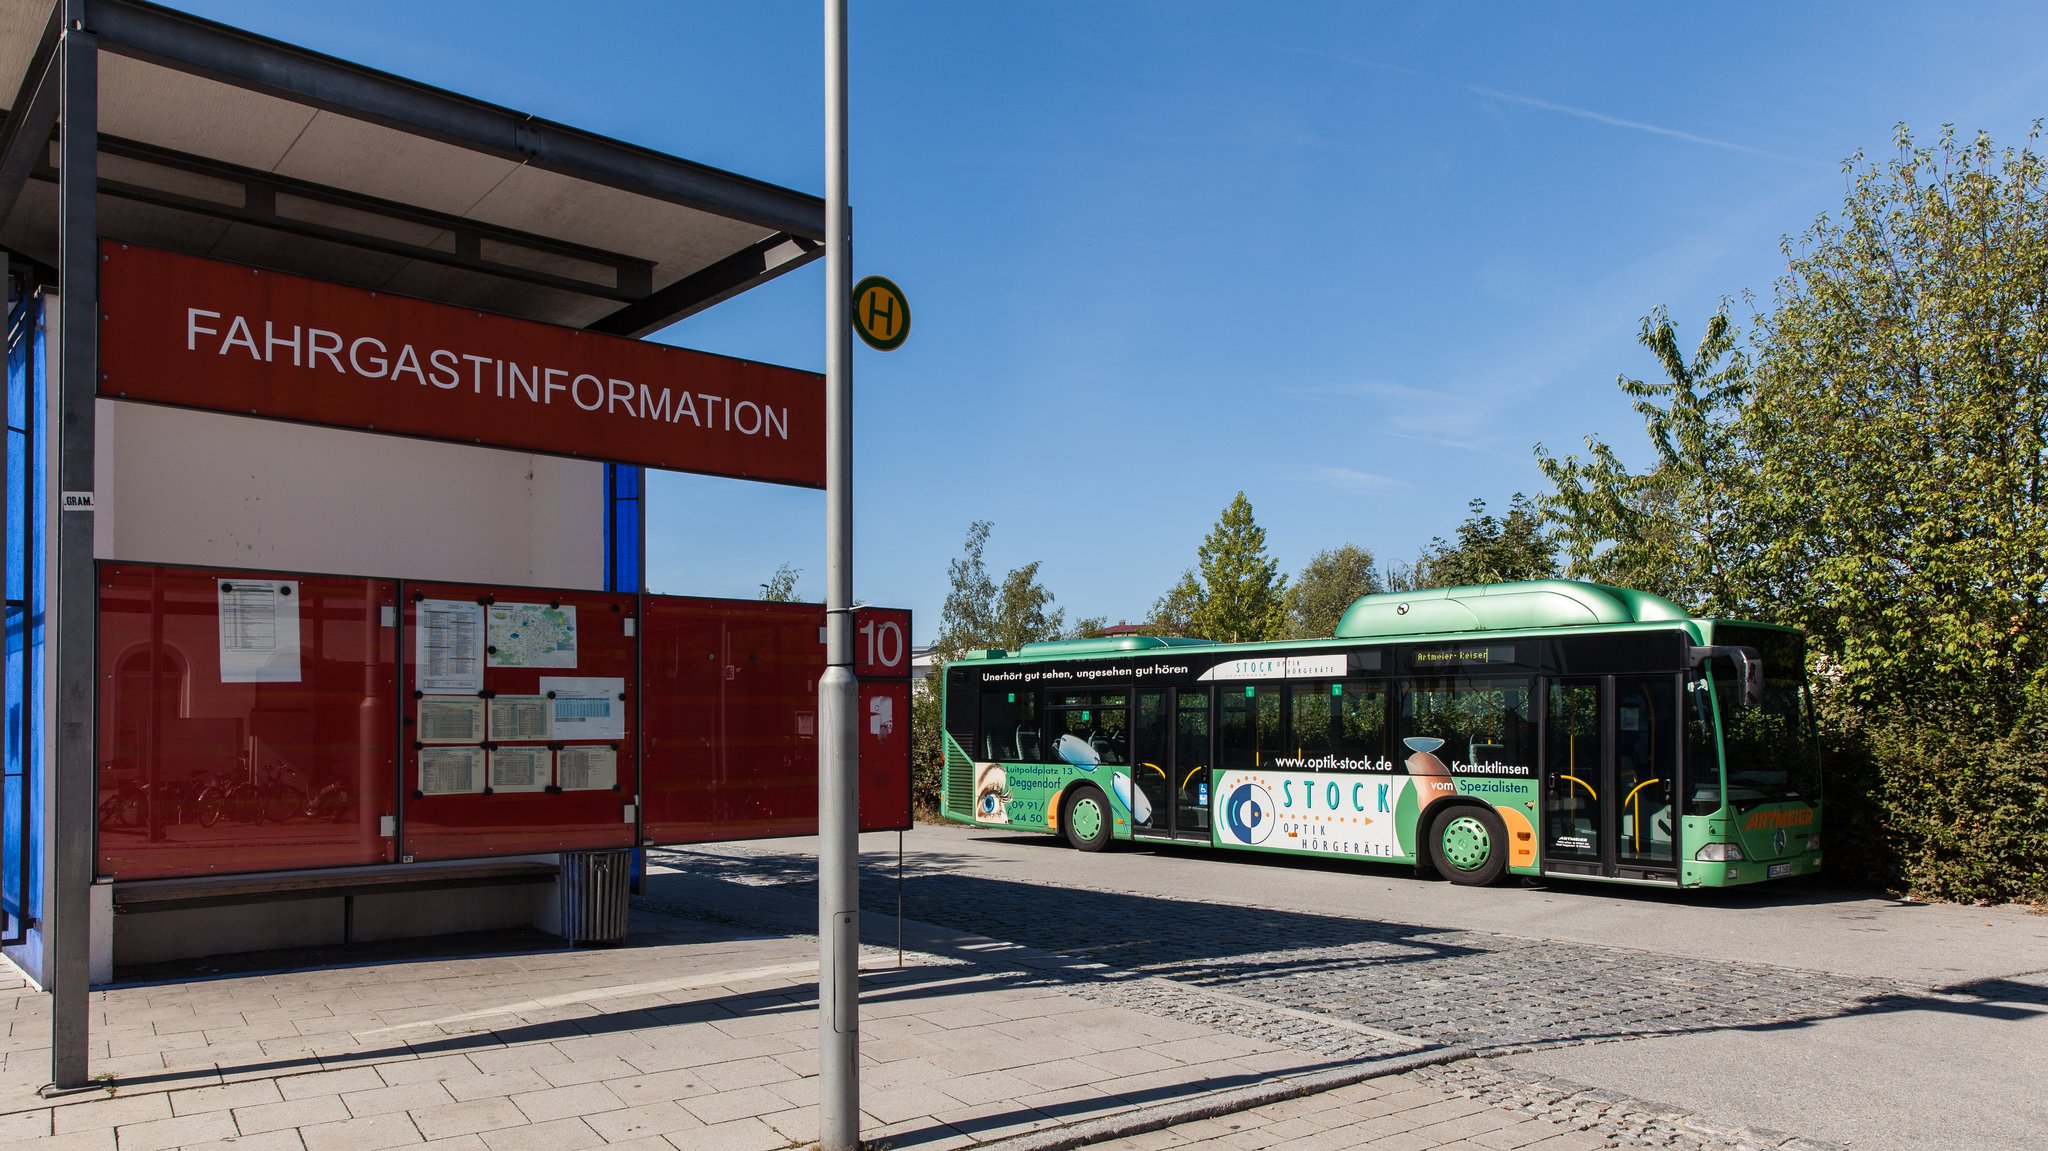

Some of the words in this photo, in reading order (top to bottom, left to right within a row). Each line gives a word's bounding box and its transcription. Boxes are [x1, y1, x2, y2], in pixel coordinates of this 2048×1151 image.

[868, 291, 893, 336] H
[187, 308, 789, 440] FAHRGASTINFORMATION
[860, 620, 903, 667] 10
[982, 671, 1022, 682] Unerhört
[1025, 671, 1040, 682] gut
[1042, 669, 1073, 680] sehen,
[1076, 667, 1132, 680] ungesehen
[1135, 666, 1153, 678] gut
[1155, 664, 1188, 675] hören
[1236, 661, 1272, 673] STOCK
[1275, 754, 1392, 772] www.optik-stock.de
[1452, 761, 1529, 775] Kontaktlinsen
[1006, 766, 1059, 776] Luitpoldplatz
[1062, 767, 1073, 775] 13
[1009, 776, 1061, 791] Deggendorf
[1431, 781, 1454, 791] vom
[1460, 779, 1529, 794] Spezialisten
[1283, 779, 1390, 813] STOCK
[1011, 801, 1024, 809] 09
[1014, 814, 1026, 822] 44
[1029, 814, 1043, 823] 50
[1283, 822, 1326, 836] OPTIK
[1301, 838, 1390, 856] HÖRGERÄTE
